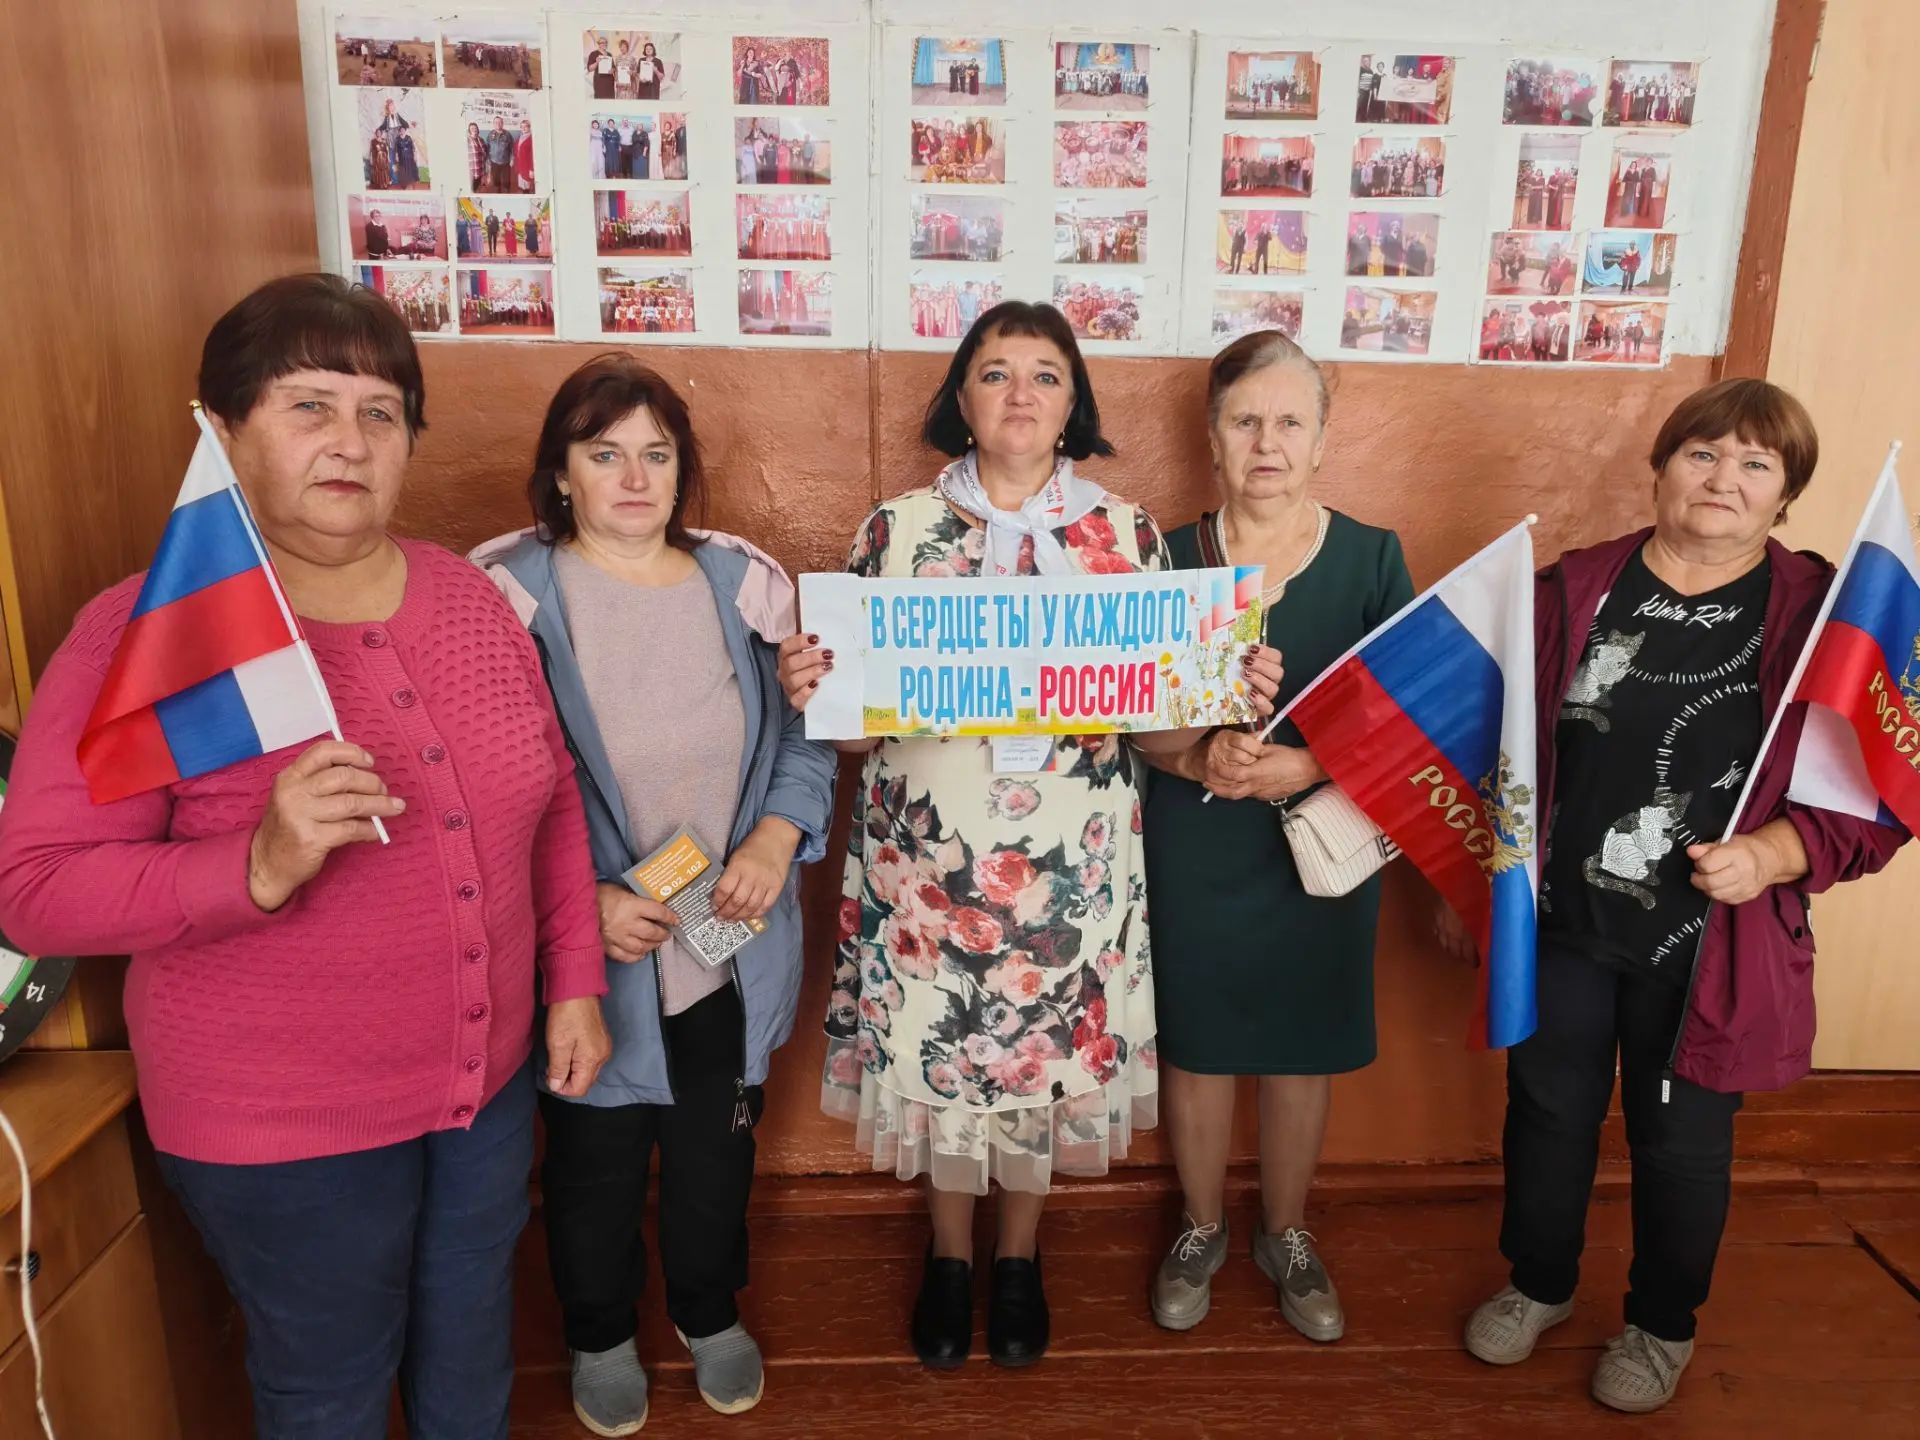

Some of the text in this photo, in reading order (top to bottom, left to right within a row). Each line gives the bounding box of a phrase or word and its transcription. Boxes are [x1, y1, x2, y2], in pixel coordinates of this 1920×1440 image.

[871, 589, 1191, 655] В СЕРДЦЕ ТЫ У КАЖДОГО,
[899, 665, 1014, 724] РОДИНА
[1040, 662, 1156, 717] РОССИЯ
[26, 981, 46, 1003] 14
